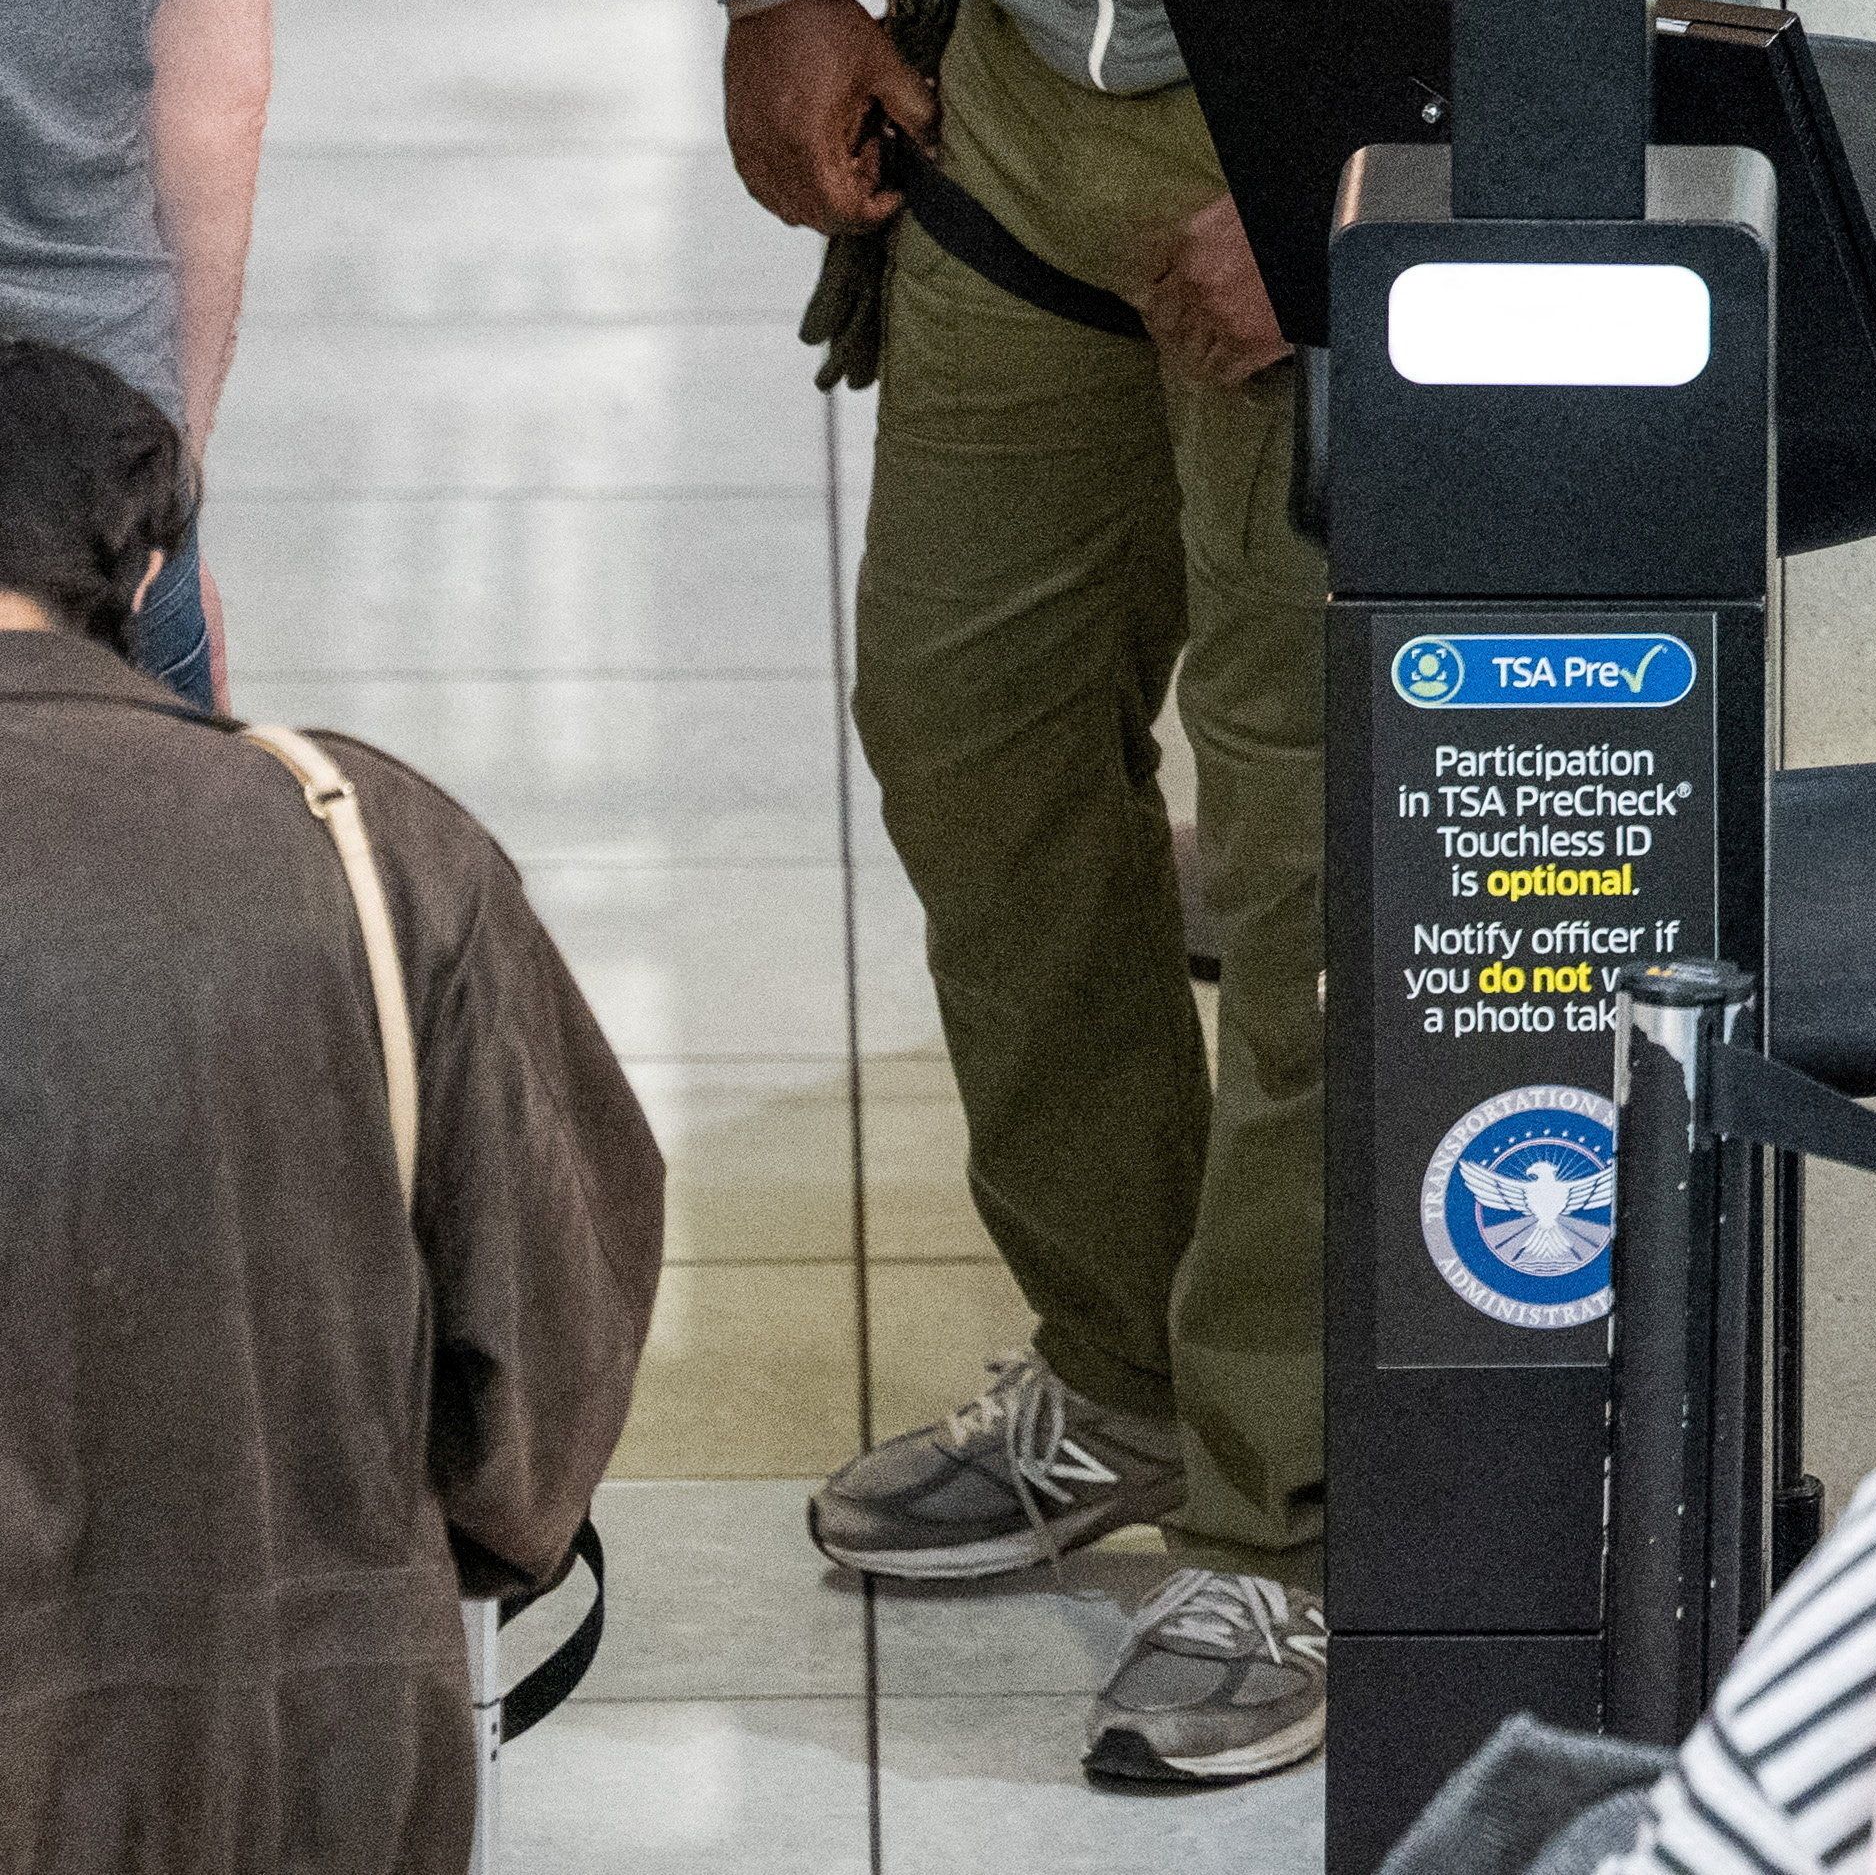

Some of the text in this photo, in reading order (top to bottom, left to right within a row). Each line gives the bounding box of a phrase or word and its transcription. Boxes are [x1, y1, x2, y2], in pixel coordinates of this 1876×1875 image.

[1491, 656, 1621, 688] TSA Pre
[1435, 743, 1654, 781] Participation
[1399, 785, 1430, 817] in
[1438, 785, 1507, 817] TSA
[1436, 824, 1651, 857] Touchless ID
[1452, 862, 1640, 902] is optional.
[1414, 919, 1681, 960] Notify officer if
[1404, 967, 1470, 1000] you
[1479, 960, 1525, 994] do
[1533, 962, 1593, 993] not
[1423, 1008, 1443, 1033] a
[1454, 1001, 1556, 1038] photo
[1425, 1089, 1597, 1222] TRANSPORTATION
